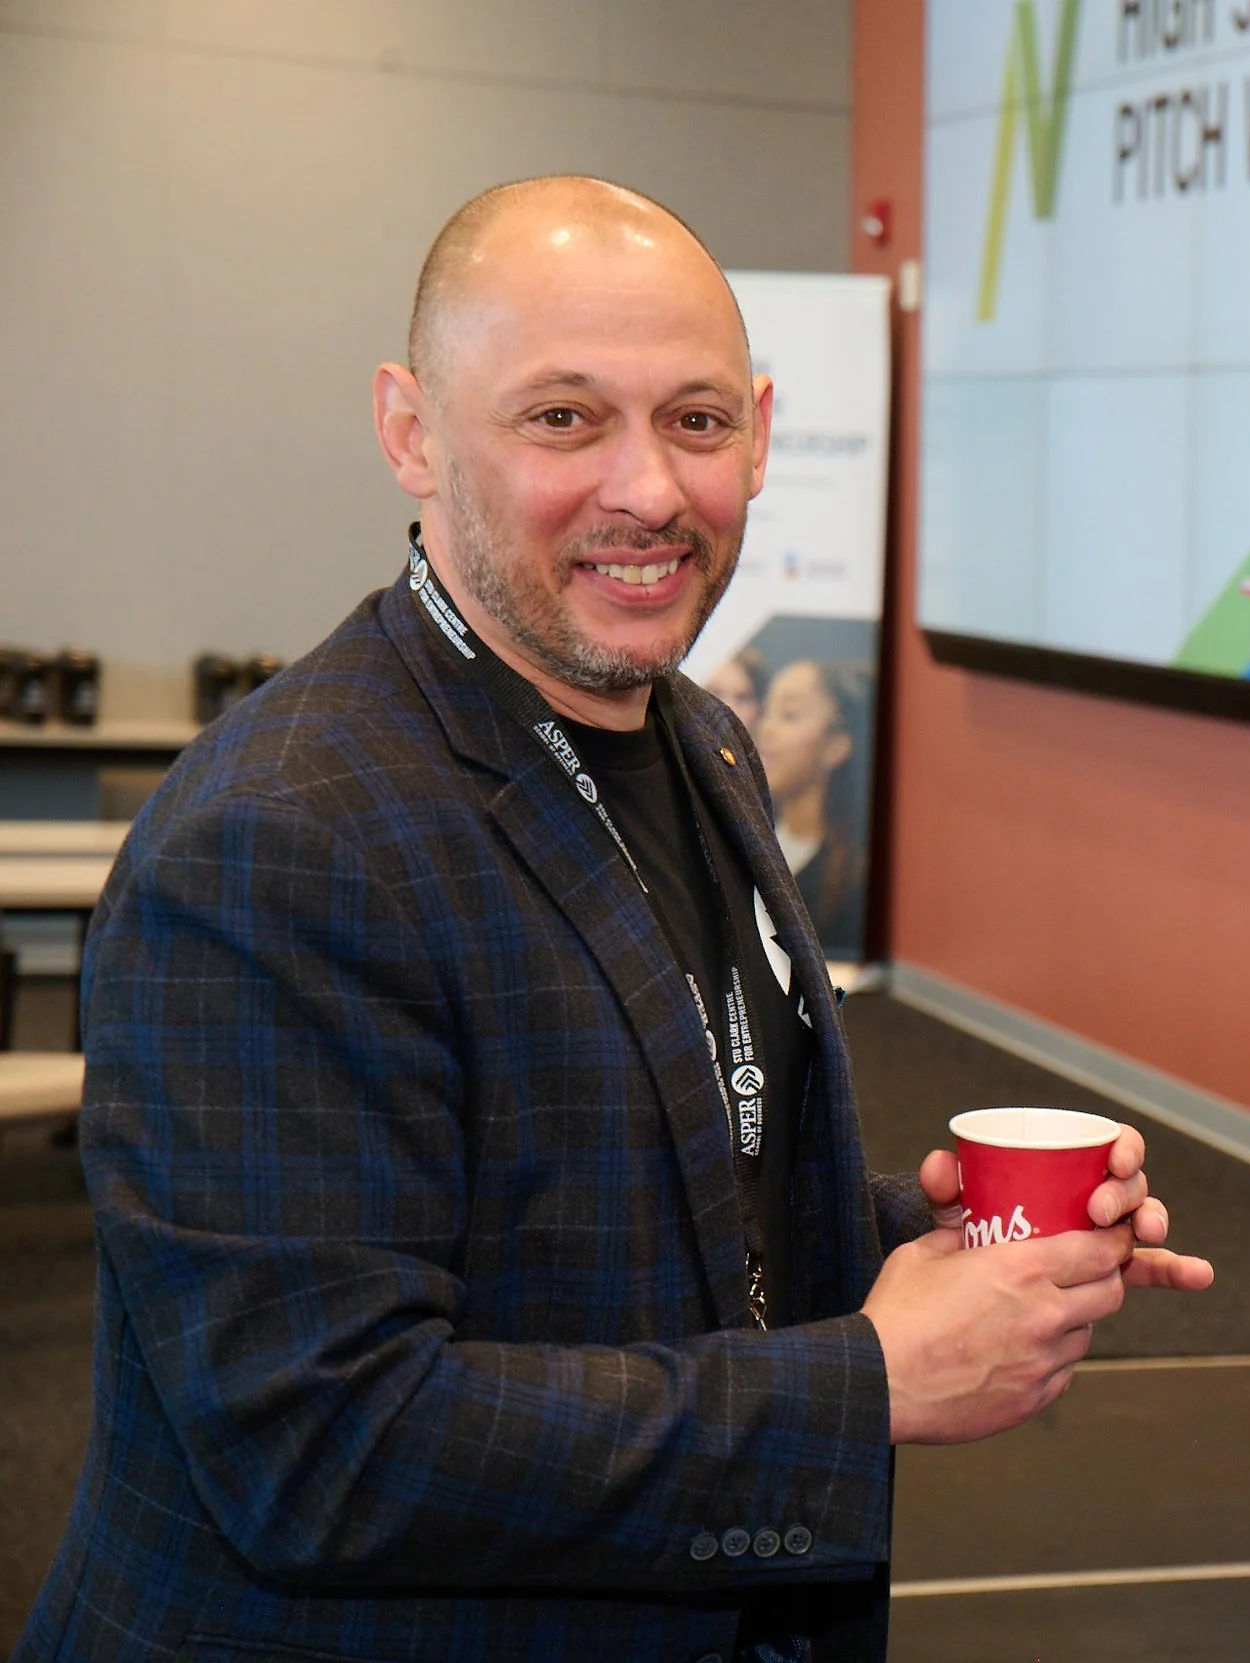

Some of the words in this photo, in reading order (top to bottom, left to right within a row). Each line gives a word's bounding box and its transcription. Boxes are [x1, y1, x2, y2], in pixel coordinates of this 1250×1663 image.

[1112, 82, 1229, 204] PITCH
[538, 719, 581, 774] ASPER
[725, 991, 738, 1022] CENTRE
[729, 1022, 741, 1048] CLARK
[732, 1048, 743, 1064] STU
[743, 1045, 755, 1062] FOR
[738, 1097, 756, 1157] ASPER
